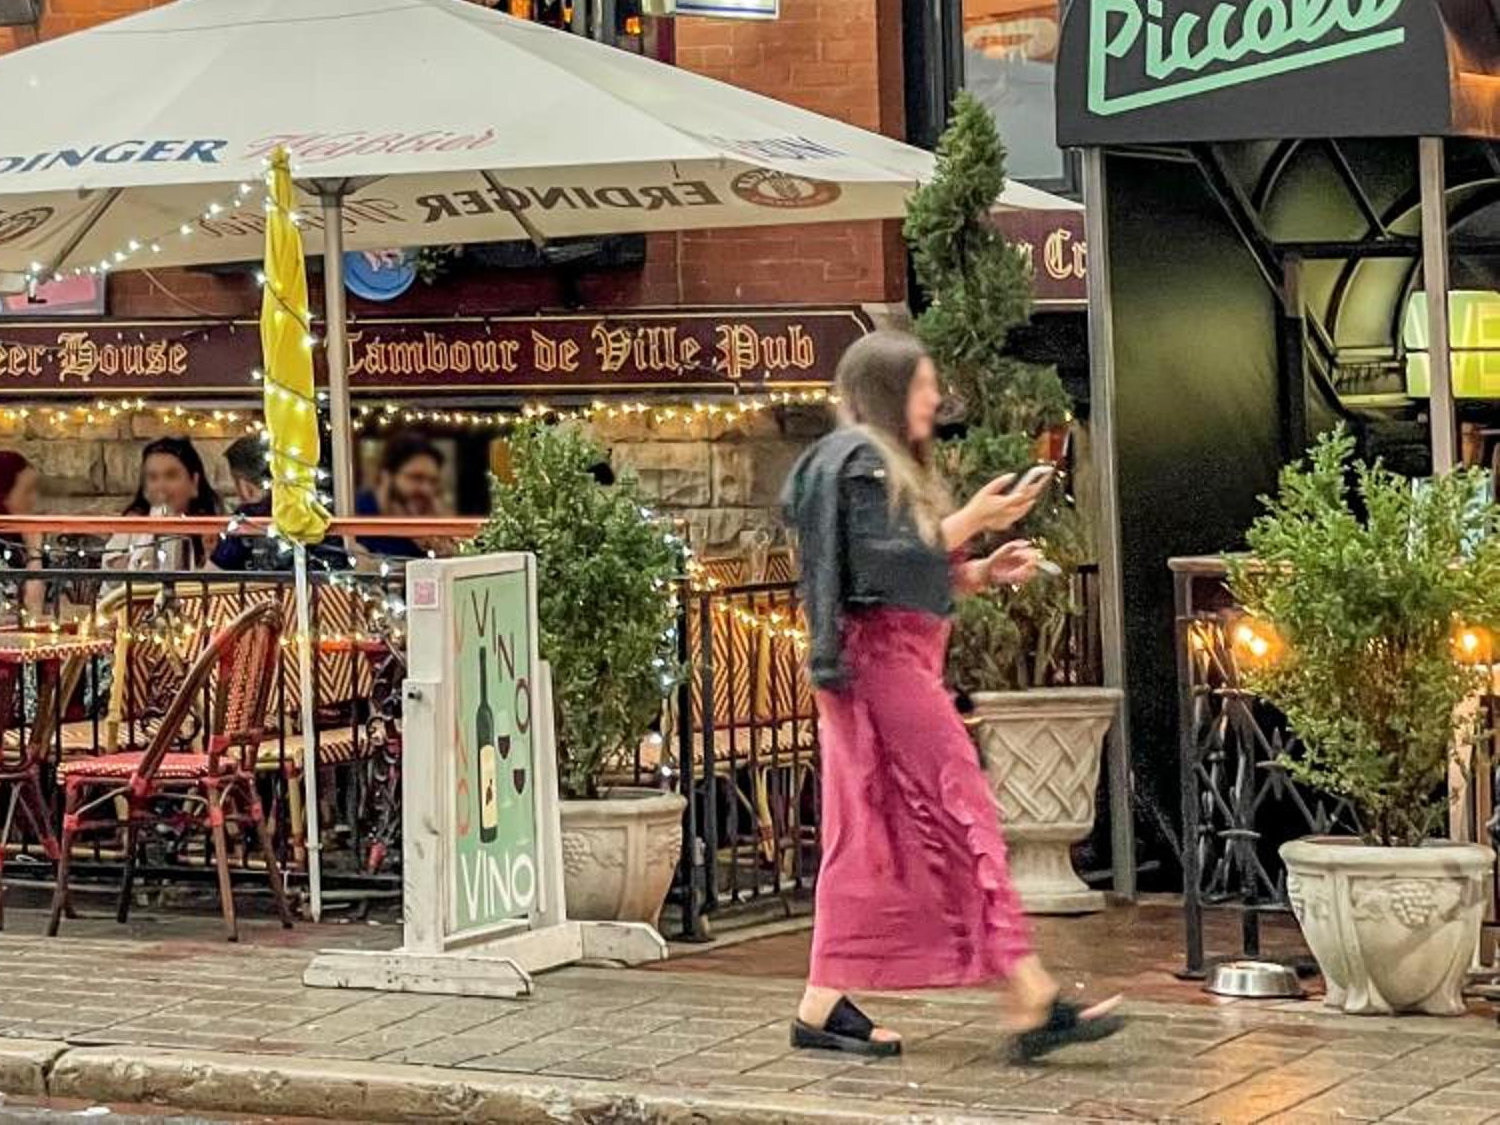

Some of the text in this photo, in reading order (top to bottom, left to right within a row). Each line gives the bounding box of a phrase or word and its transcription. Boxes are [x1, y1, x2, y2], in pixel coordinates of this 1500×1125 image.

[57, 329, 188, 383] House
[530, 328, 581, 373] de
[591, 324, 701, 373] Ville
[714, 323, 816, 379] Pub
[471, 588, 530, 734] VINO
[461, 849, 535, 922] VINO
